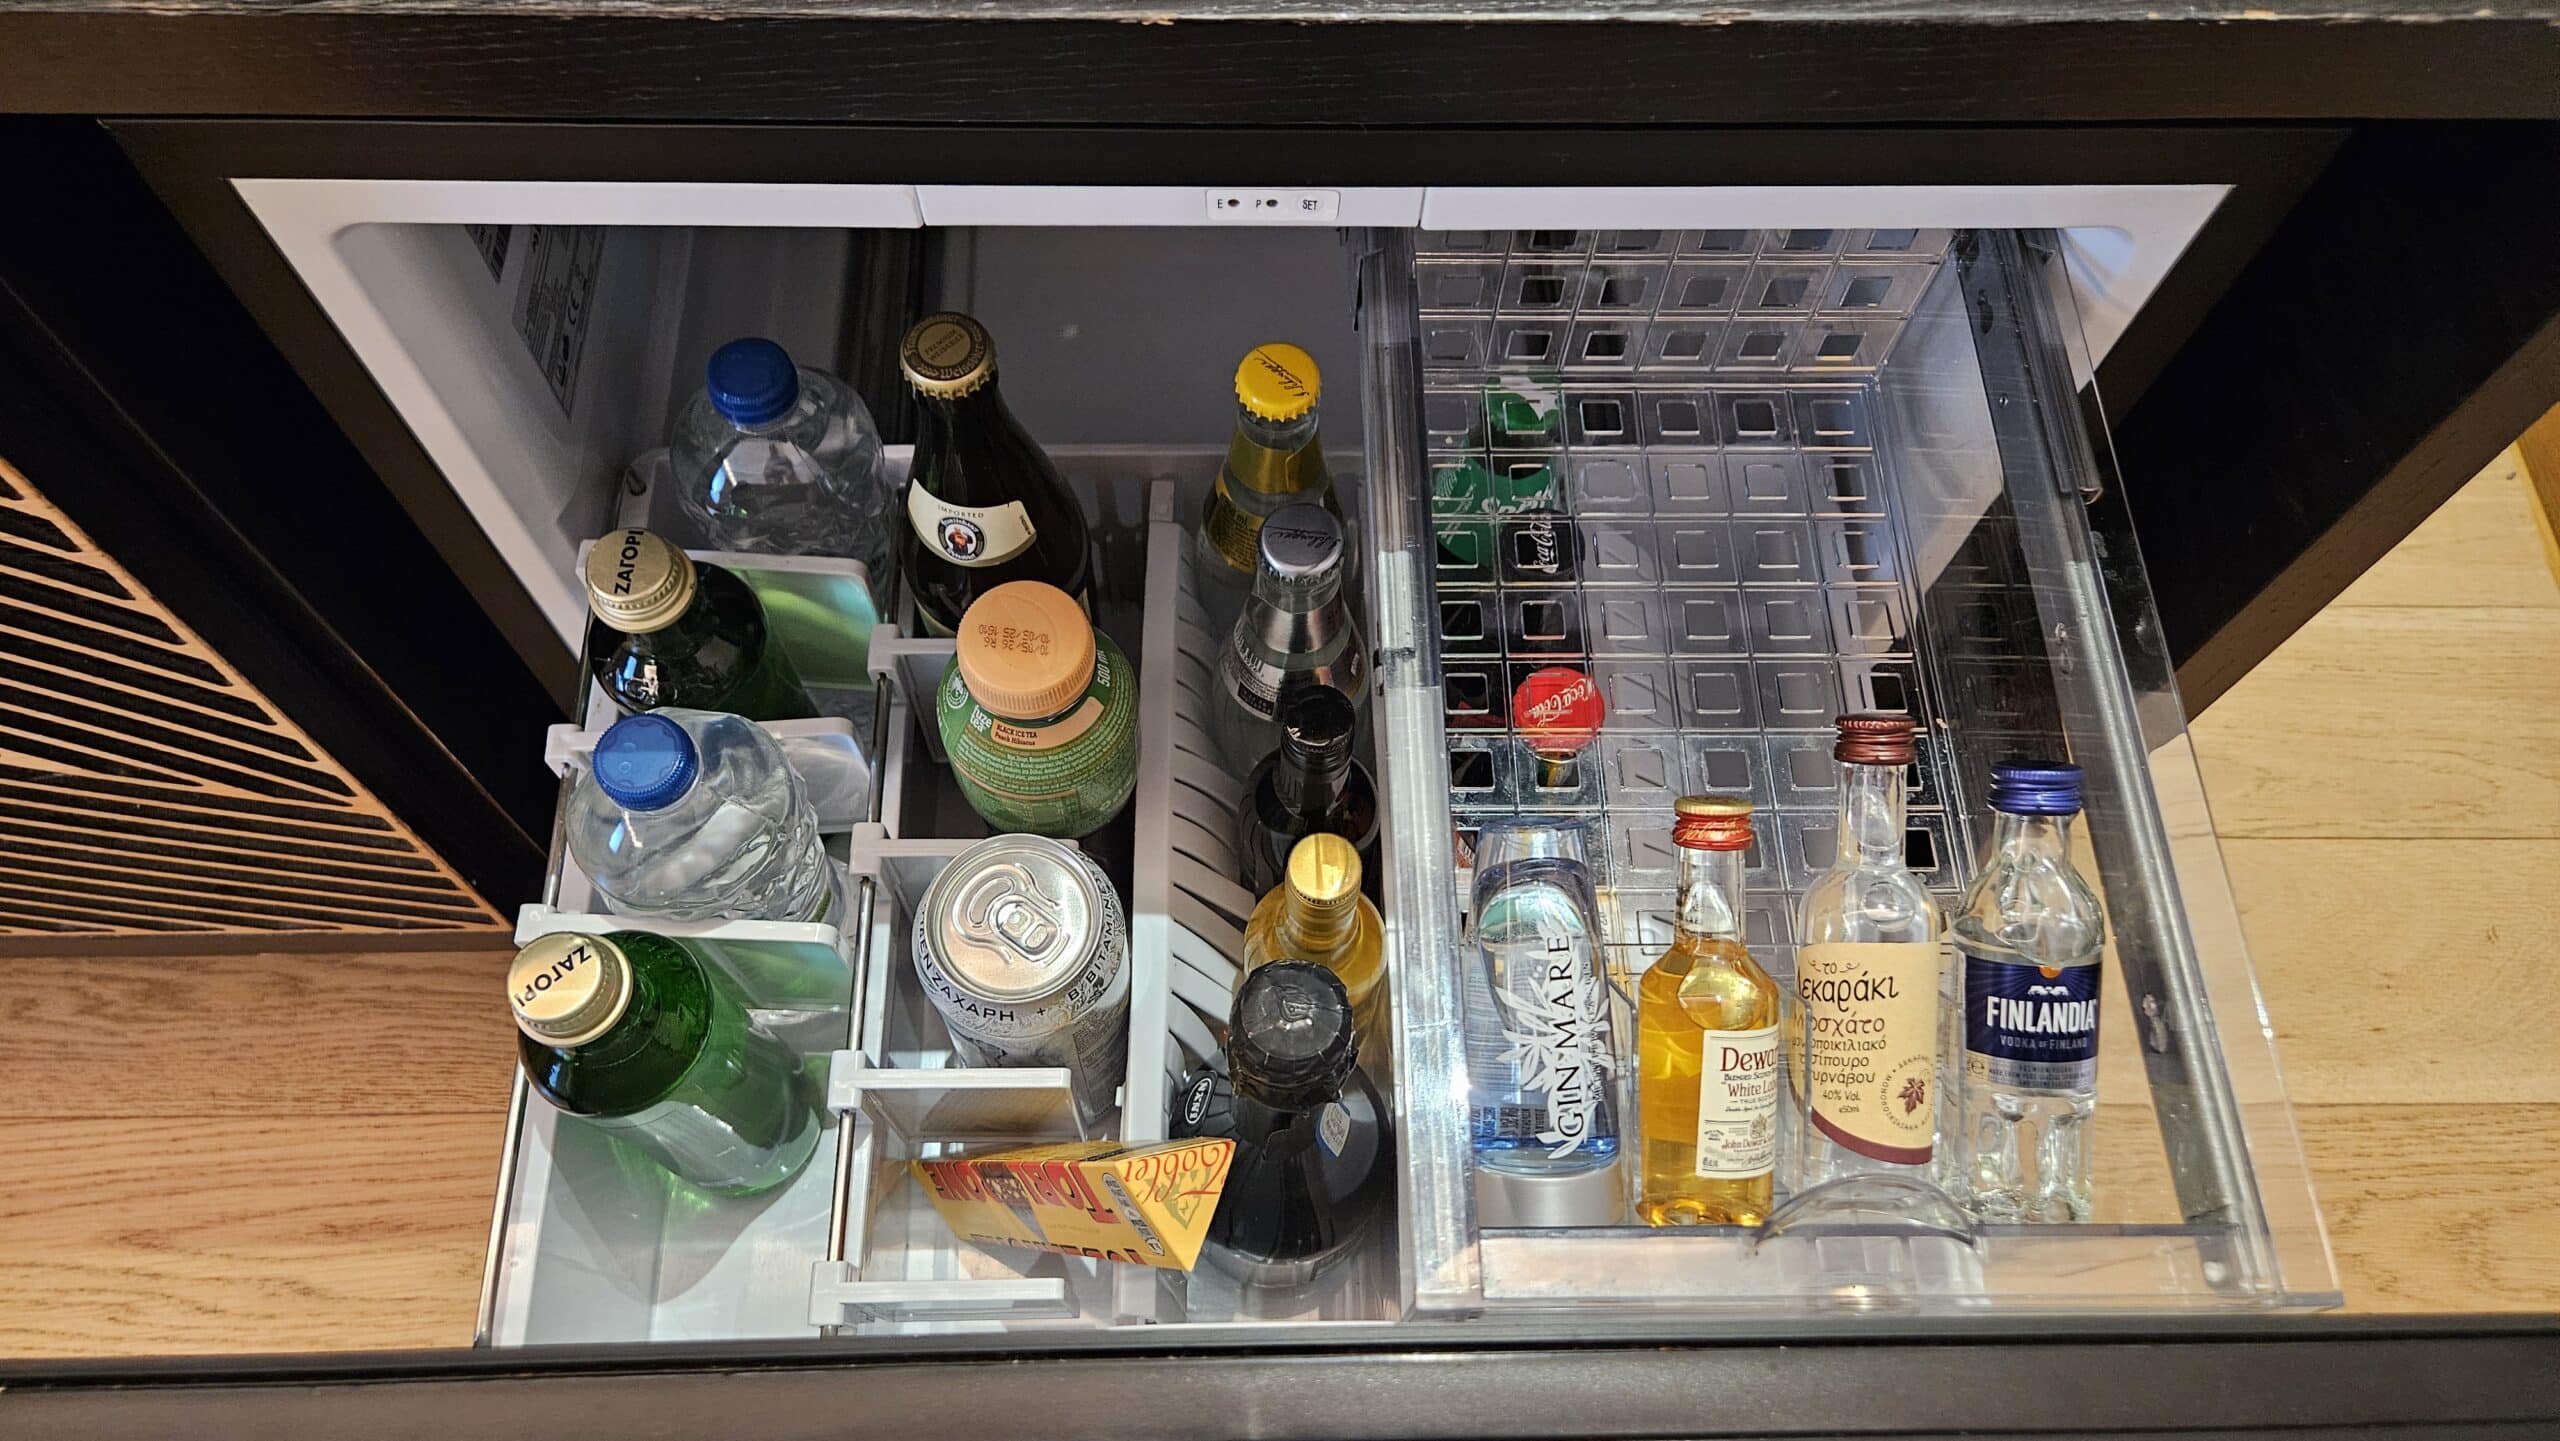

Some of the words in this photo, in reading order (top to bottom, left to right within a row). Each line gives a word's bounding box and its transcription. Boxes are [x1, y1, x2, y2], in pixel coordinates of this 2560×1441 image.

[1217, 199, 1223, 209] E
[1255, 199, 1262, 208] P
[1302, 199, 1318, 211] SET
[937, 505, 985, 519] IMPORTED
[614, 530, 643, 594] ΖΑΓΟΡΙ
[1097, 664, 1110, 687] 500
[996, 724, 1015, 735] BLACK
[1015, 730, 1026, 738] ICE
[1025, 731, 1038, 739] TEA
[514, 945, 592, 1007] ΖΑΓΟΡΙ
[1822, 962, 1837, 975] το
[1548, 935, 1578, 1057] MARE
[1798, 965, 1899, 1012] εκαράκι
[932, 972, 1014, 1021] ΖΑΧΑΡΗ
[1986, 995, 2097, 1034] FINLANDIA
[2000, 1034, 2036, 1049] VODKA
[2050, 1037, 2088, 1049] FINLAND
[1728, 1082, 1761, 1097] White
[1822, 1090, 1842, 1100] 40%
[1556, 1068, 1585, 1138] GIN
